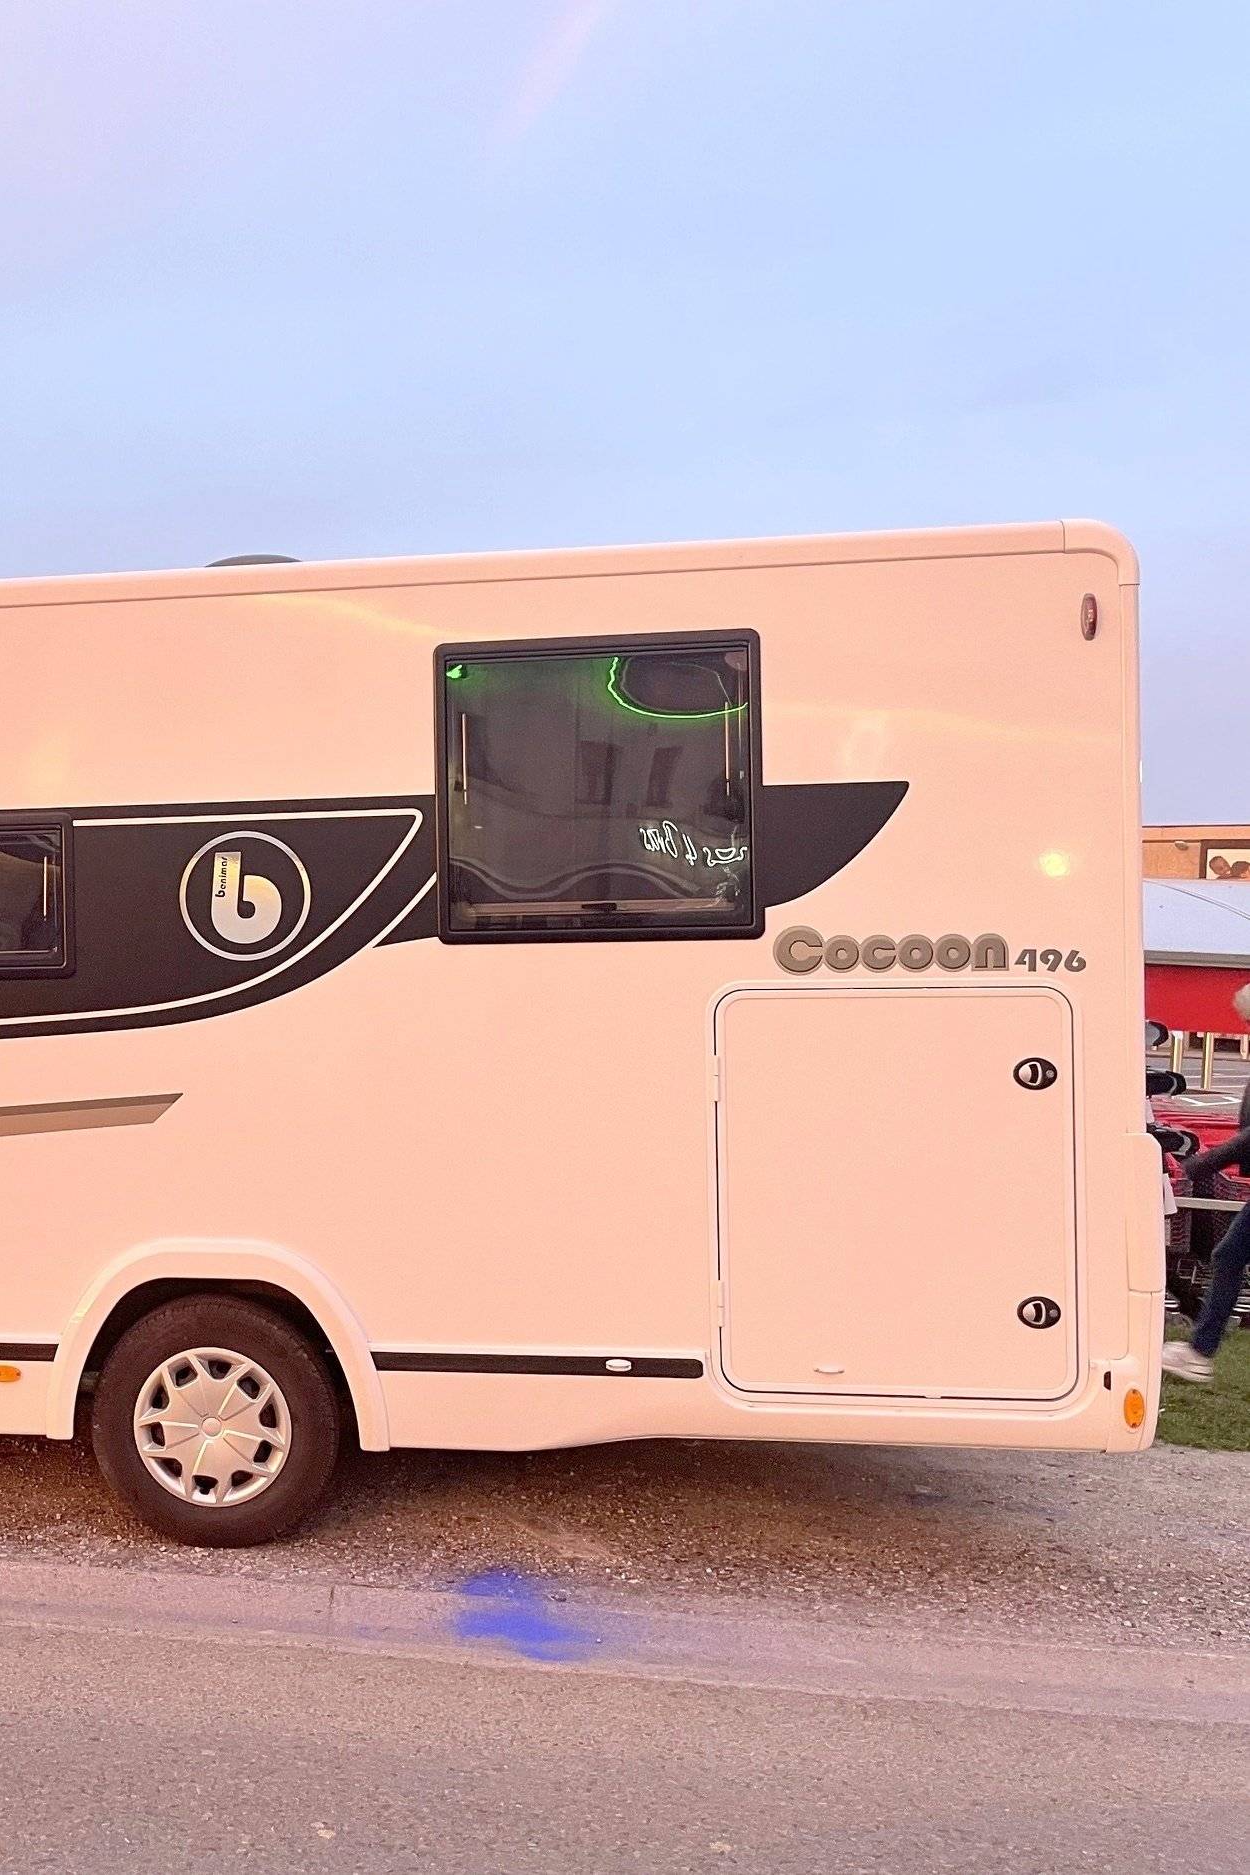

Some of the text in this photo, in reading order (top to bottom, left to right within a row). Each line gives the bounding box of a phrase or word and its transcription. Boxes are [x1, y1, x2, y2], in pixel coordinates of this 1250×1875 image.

[214, 856, 228, 898] benimar
[772, 925, 1087, 976] Cocoon 496
